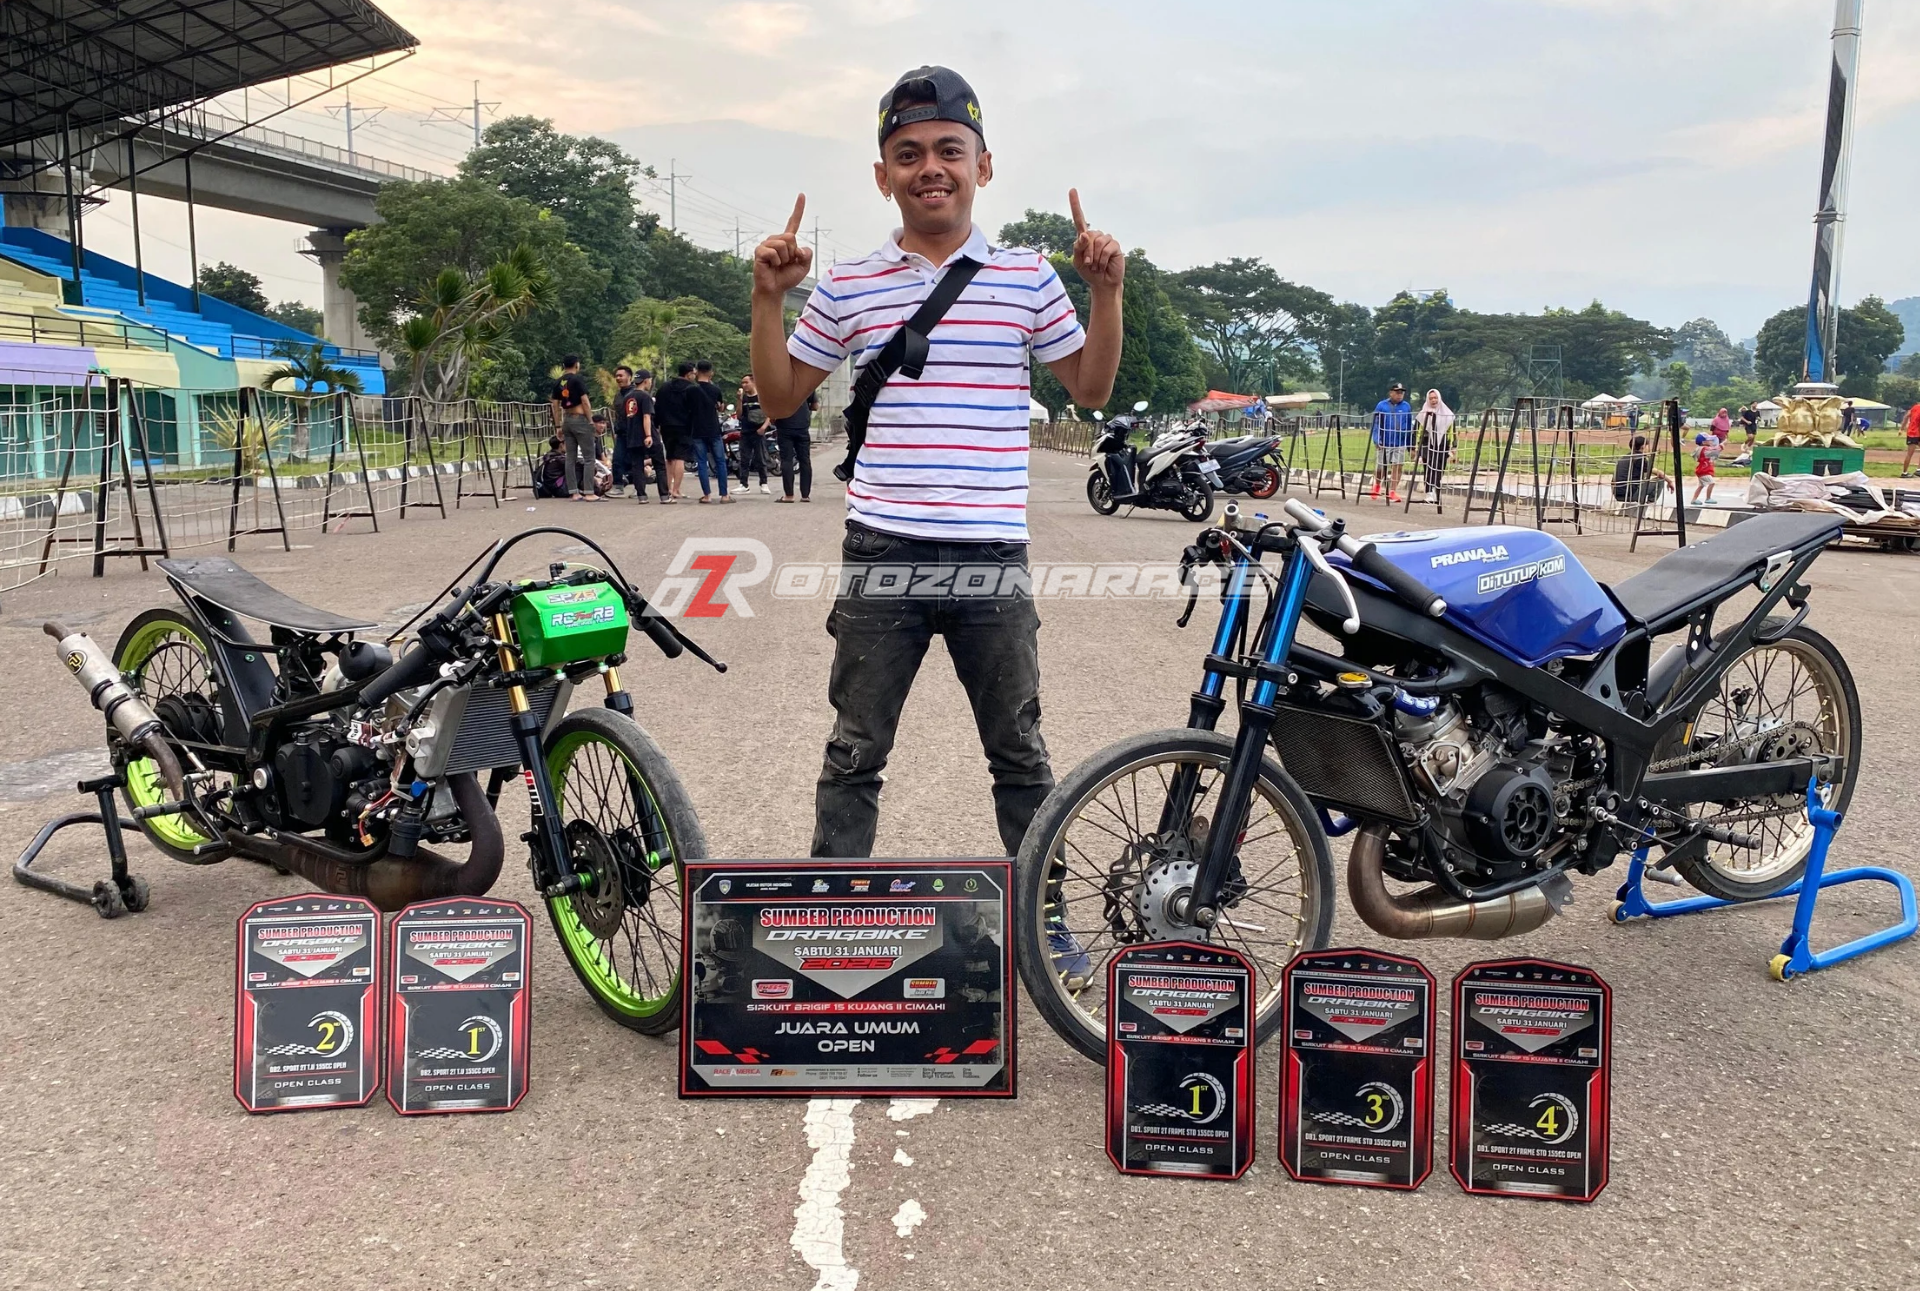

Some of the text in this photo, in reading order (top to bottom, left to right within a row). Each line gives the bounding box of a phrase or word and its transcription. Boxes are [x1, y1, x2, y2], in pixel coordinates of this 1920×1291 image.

[1430, 545, 1508, 569] PRANAJA
[1539, 558, 1564, 577] KOM
[760, 907, 936, 927] SUMBER PRODUCTION
[258, 924, 362, 939] SUMBER PRODUCTION
[409, 929, 513, 942] SUMBER PRODUCTION
[766, 929, 929, 941] DRAGBIKE
[261, 936, 359, 947] DRAGBIKE
[413, 941, 509, 950] DRAGBIKE
[794, 945, 903, 956] SABTU 31 JANUARI
[800, 957, 897, 970] 2026
[1128, 974, 1235, 992] SUMBER PRODUCTION
[1132, 988, 1231, 1000] DRAGBIKE
[1304, 982, 1415, 1002] SUMBER PRODUCTION
[794, 1003, 831, 1011] BRIGIF
[1307, 996, 1410, 1010] DRAGBIKE
[1475, 992, 1589, 1011] SUMBER PRODUCTION
[1324, 1007, 1349, 1015] SABTU
[1479, 1006, 1585, 1019] DRAGBIKE
[775, 1021, 920, 1034] JUARA UMUM
[316, 1022, 335, 1050] 2
[467, 1027, 480, 1055] 1
[818, 1040, 874, 1052] OPEN
[307, 1078, 341, 1086] CLASS
[1189, 1085, 1203, 1115] 1
[1365, 1094, 1383, 1124] 3
[1536, 1105, 1559, 1135] 4
[1143, 1126, 1160, 1134] SPORT
[1168, 1127, 1185, 1135] FRAME
[1197, 1129, 1214, 1137] 155CC
[1214, 1130, 1229, 1138] OPEN
[1318, 1134, 1335, 1142] SPORT
[1343, 1136, 1361, 1144] FRAME
[1362, 1137, 1372, 1145] STD
[1392, 1140, 1407, 1148] OPEN
[1178, 1146, 1214, 1154] CLASS
[1490, 1146, 1508, 1154] SPORT
[1509, 1147, 1516, 1155] 2T
[1516, 1147, 1535, 1156] FRAME
[1536, 1149, 1547, 1157] STD
[1548, 1150, 1566, 1158] 155CC
[1566, 1151, 1582, 1159] OPEN
[1320, 1151, 1390, 1163] OPEN CLASS
[1492, 1163, 1565, 1175] OPEN CLASS
